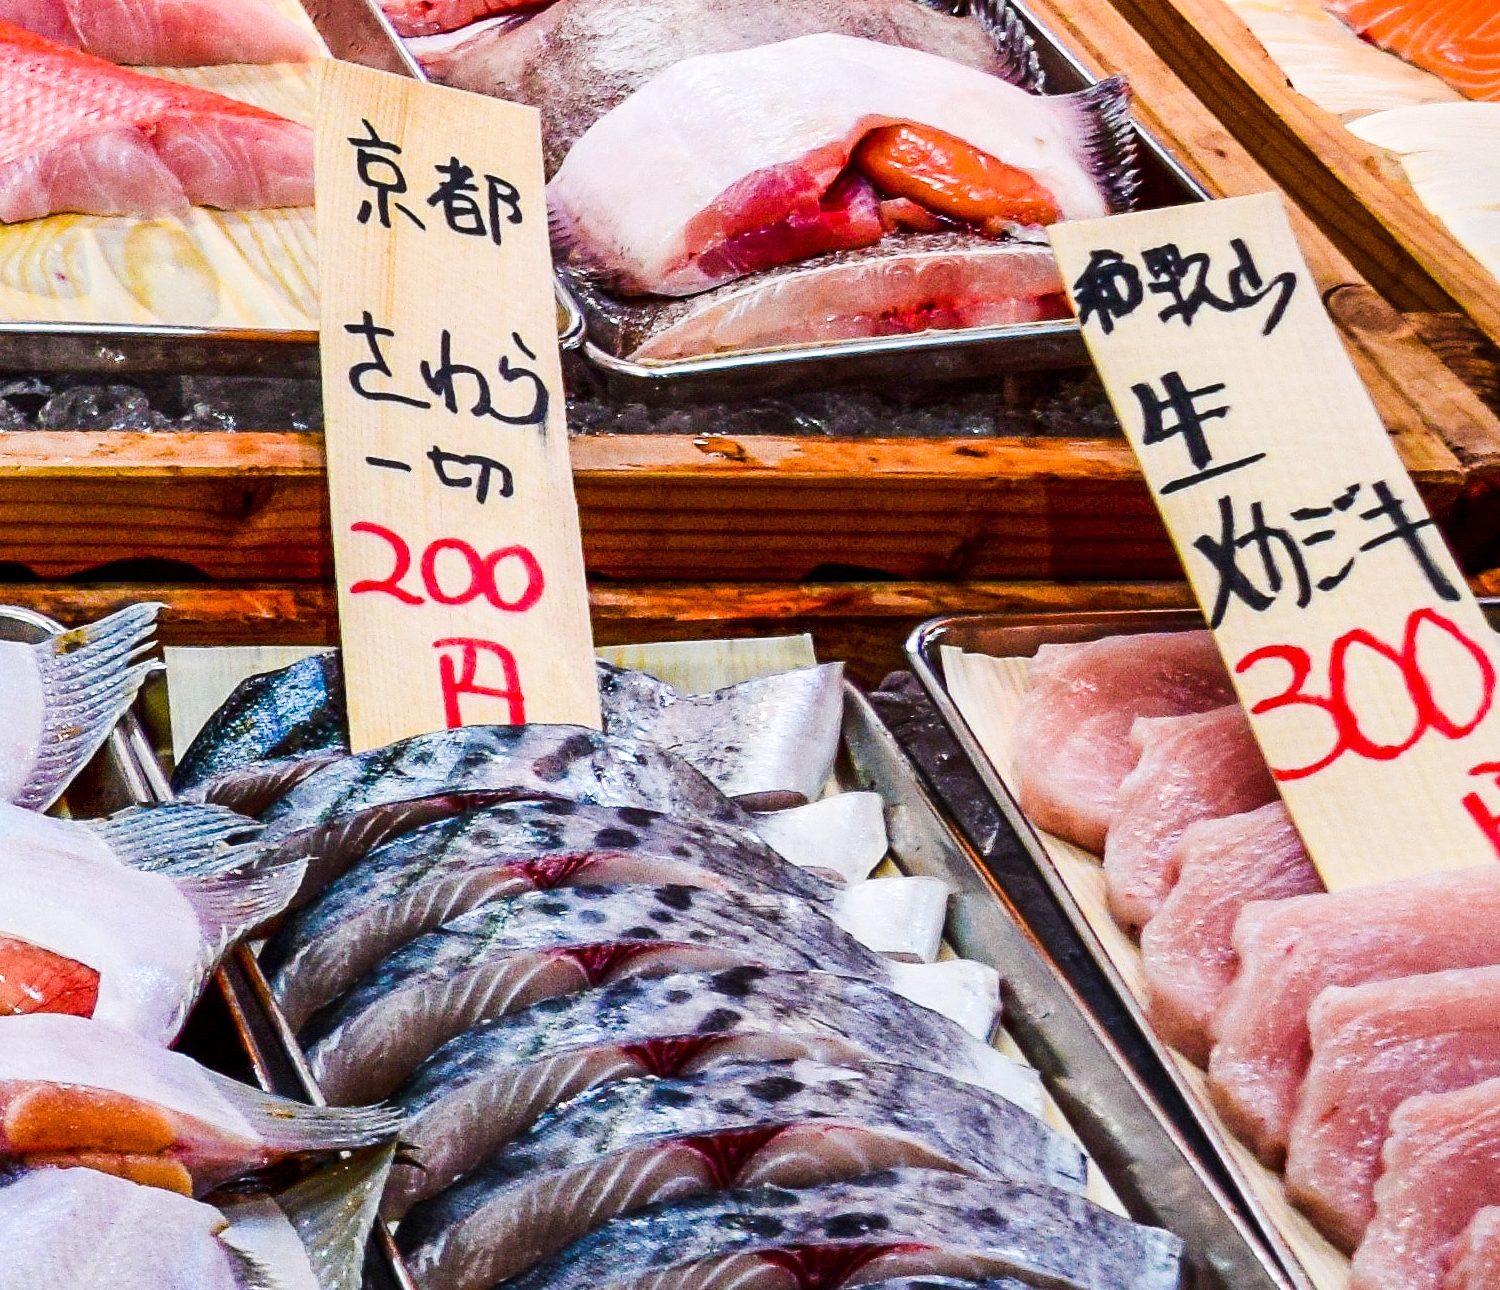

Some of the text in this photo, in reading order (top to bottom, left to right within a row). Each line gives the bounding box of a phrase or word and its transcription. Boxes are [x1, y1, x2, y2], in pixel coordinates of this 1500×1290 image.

[347, 119, 522, 245] 京都
[1072, 237, 1298, 335] 和歌山
[344, 309, 548, 425] さわら
[1131, 369, 1266, 495] 生
[349, 520, 545, 612] 200
[1193, 478, 1461, 630] メカジキ
[432, 634, 526, 729] 円
[1235, 607, 1497, 782] 300
